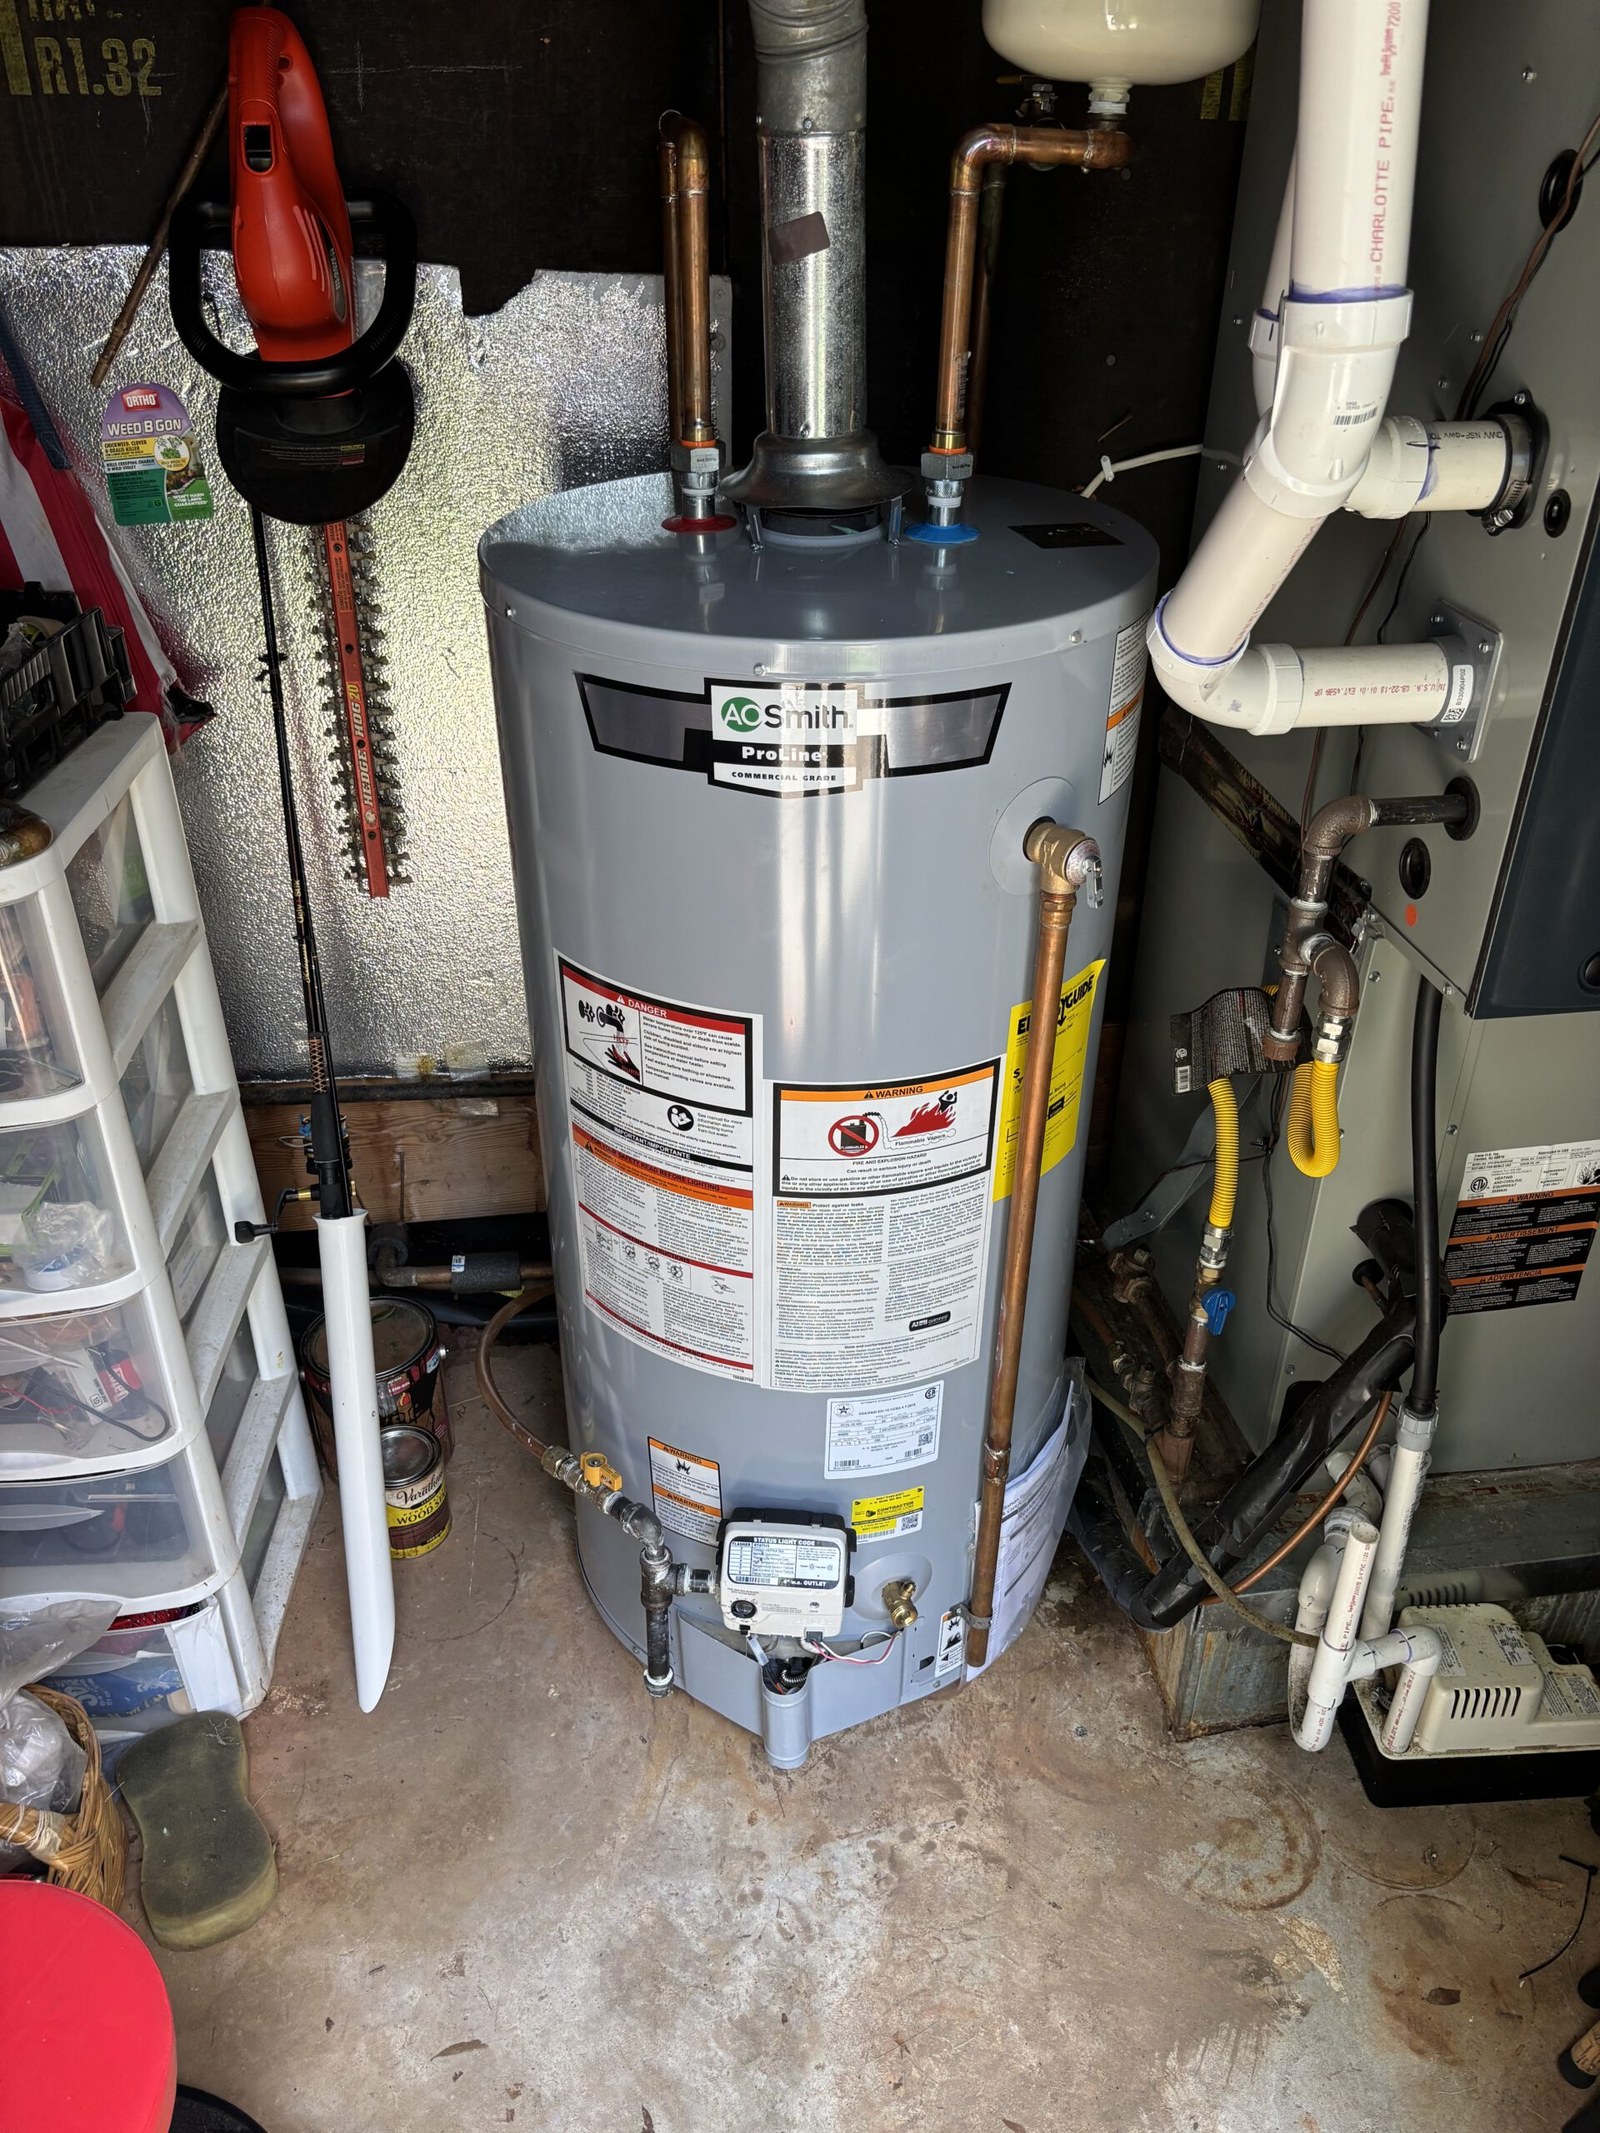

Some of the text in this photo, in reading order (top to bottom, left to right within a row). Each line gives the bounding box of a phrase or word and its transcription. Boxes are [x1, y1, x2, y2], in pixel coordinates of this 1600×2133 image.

[1378, 101, 1395, 149] PIPE
[1370, 159, 1390, 263] CHARLOTTE
[126, 394, 156, 408] ORTHO
[107, 418, 182, 436] WEED B GON
[764, 704, 848, 729] Smith
[346, 683, 374, 808] HEDGE HOG 20
[742, 746, 822, 762] ProLine
[732, 770, 836, 782] COMMERCIAL GRADE
[628, 1000, 668, 1018] DANGER
[656, 1020, 682, 1030] temperature
[643, 1030, 662, 1039] Children,
[663, 1036, 682, 1044] disabled
[671, 1030, 690, 1039] instantly
[645, 1049, 669, 1060] temperature
[645, 1064, 671, 1076] Temperature
[713, 1082, 736, 1090] available.
[682, 1067, 699, 1076] bathing
[706, 1073, 731, 1082] showering.
[876, 1085, 923, 1099] WARNING
[895, 1137, 925, 1146] Flammable
[1516, 1192, 1554, 1201] WARNING
[1494, 1226, 1560, 1240] AVERTISSEMENT
[1488, 1269, 1542, 1282] ADVERTENCIA
[668, 1448, 702, 1464] WARNING
[672, 1494, 705, 1511] WARNING
[396, 1504, 434, 1525] WOOD
